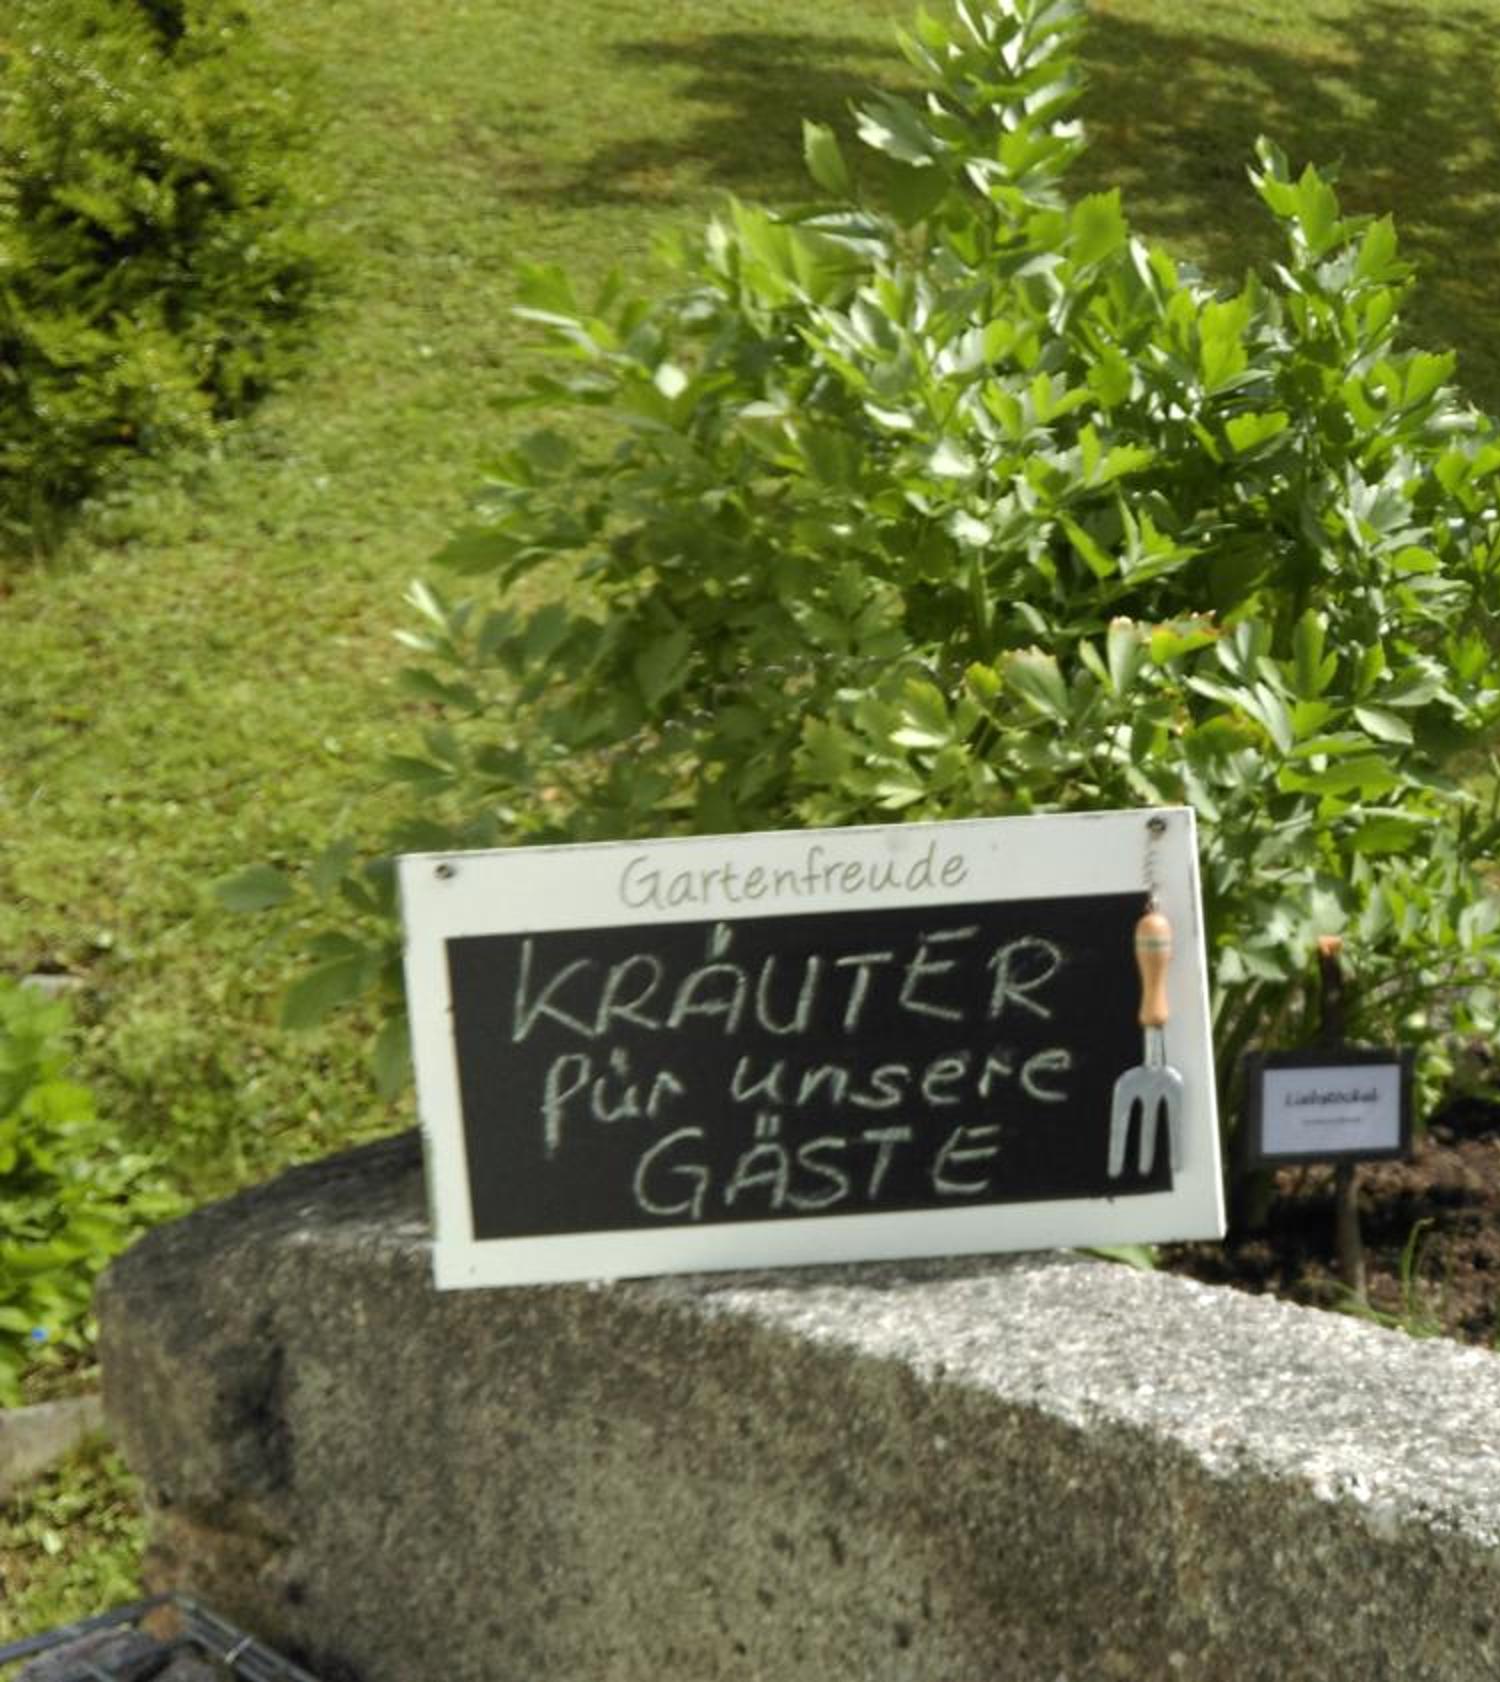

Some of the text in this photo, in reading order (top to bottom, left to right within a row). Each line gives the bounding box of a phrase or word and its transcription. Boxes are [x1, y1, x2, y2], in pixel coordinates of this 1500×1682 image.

[619, 840, 968, 911] Gartenfreude
[512, 922, 1063, 1043] KRÄUTER
[541, 1045, 1073, 1159] für unsere
[633, 1113, 1000, 1219] GÄSTE
